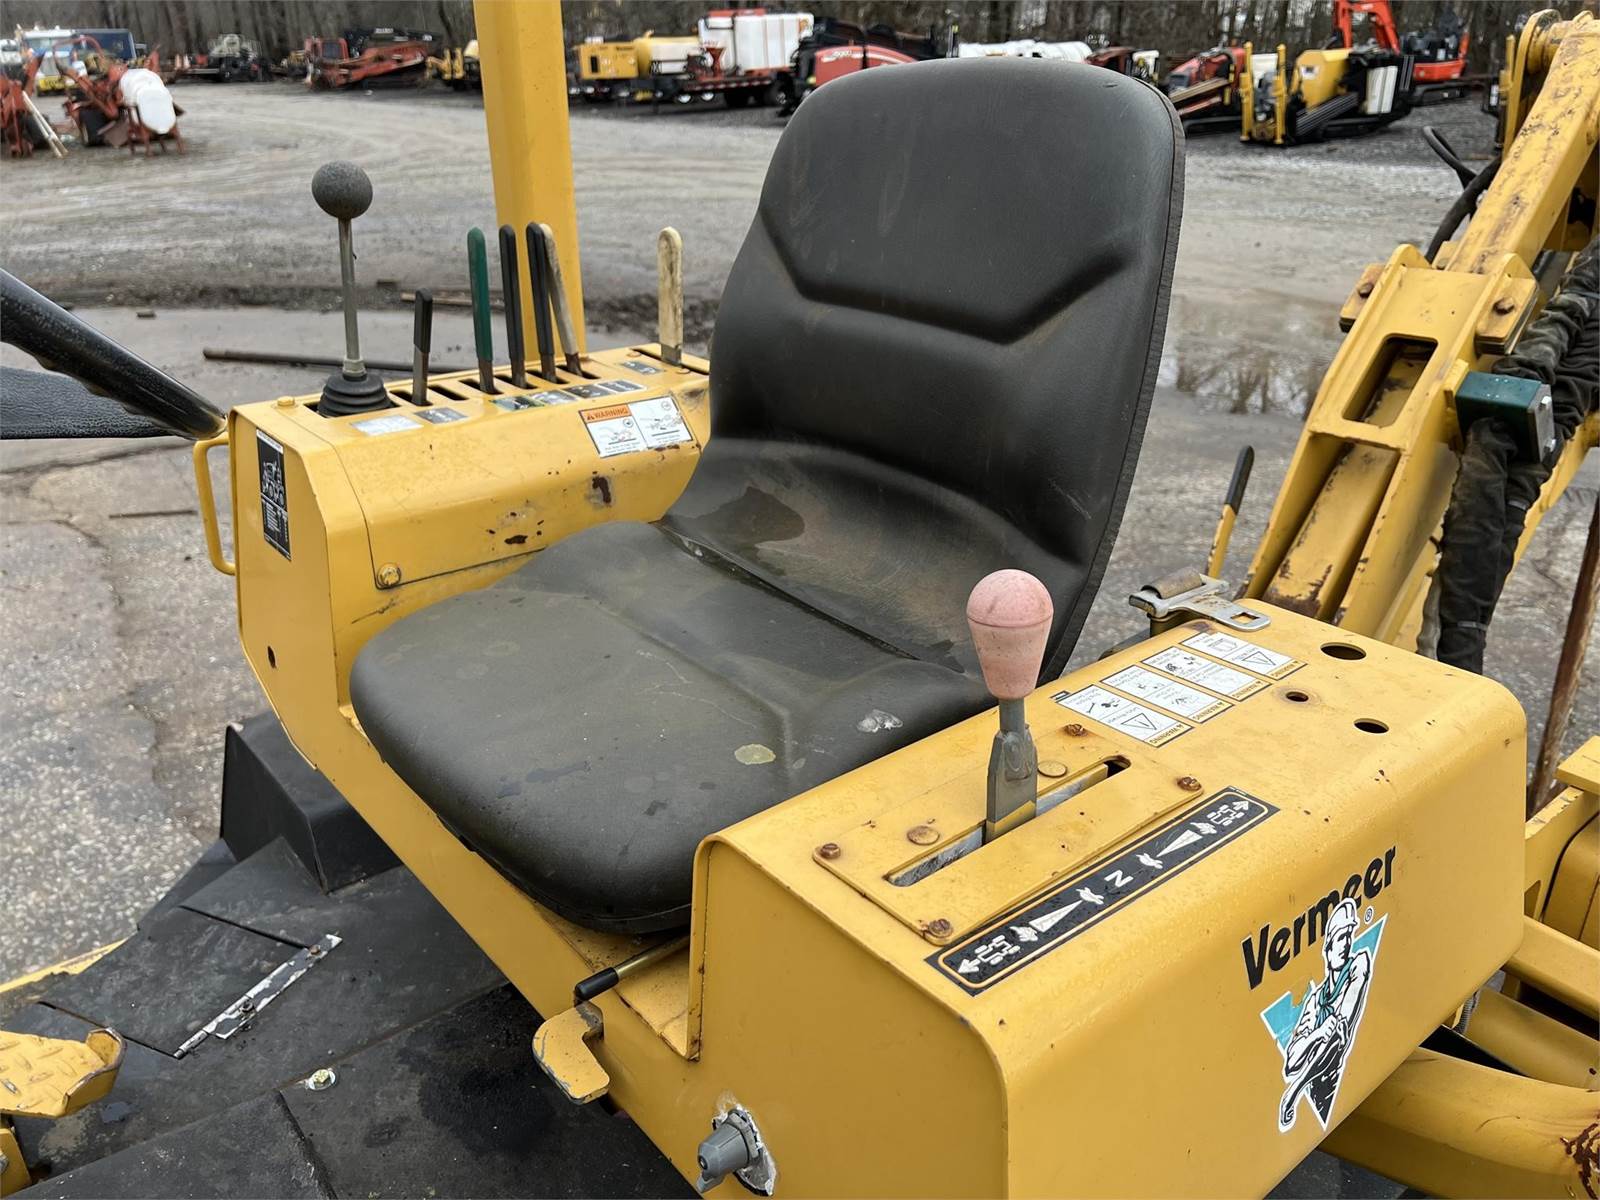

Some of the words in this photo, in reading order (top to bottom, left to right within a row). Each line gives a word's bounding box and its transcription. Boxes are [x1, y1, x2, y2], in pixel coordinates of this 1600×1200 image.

[593, 407, 630, 419] WARNING
[1149, 726, 1180, 744] WARNING
[1103, 869, 1134, 888] N
[1241, 846, 1397, 991] Vermeer
